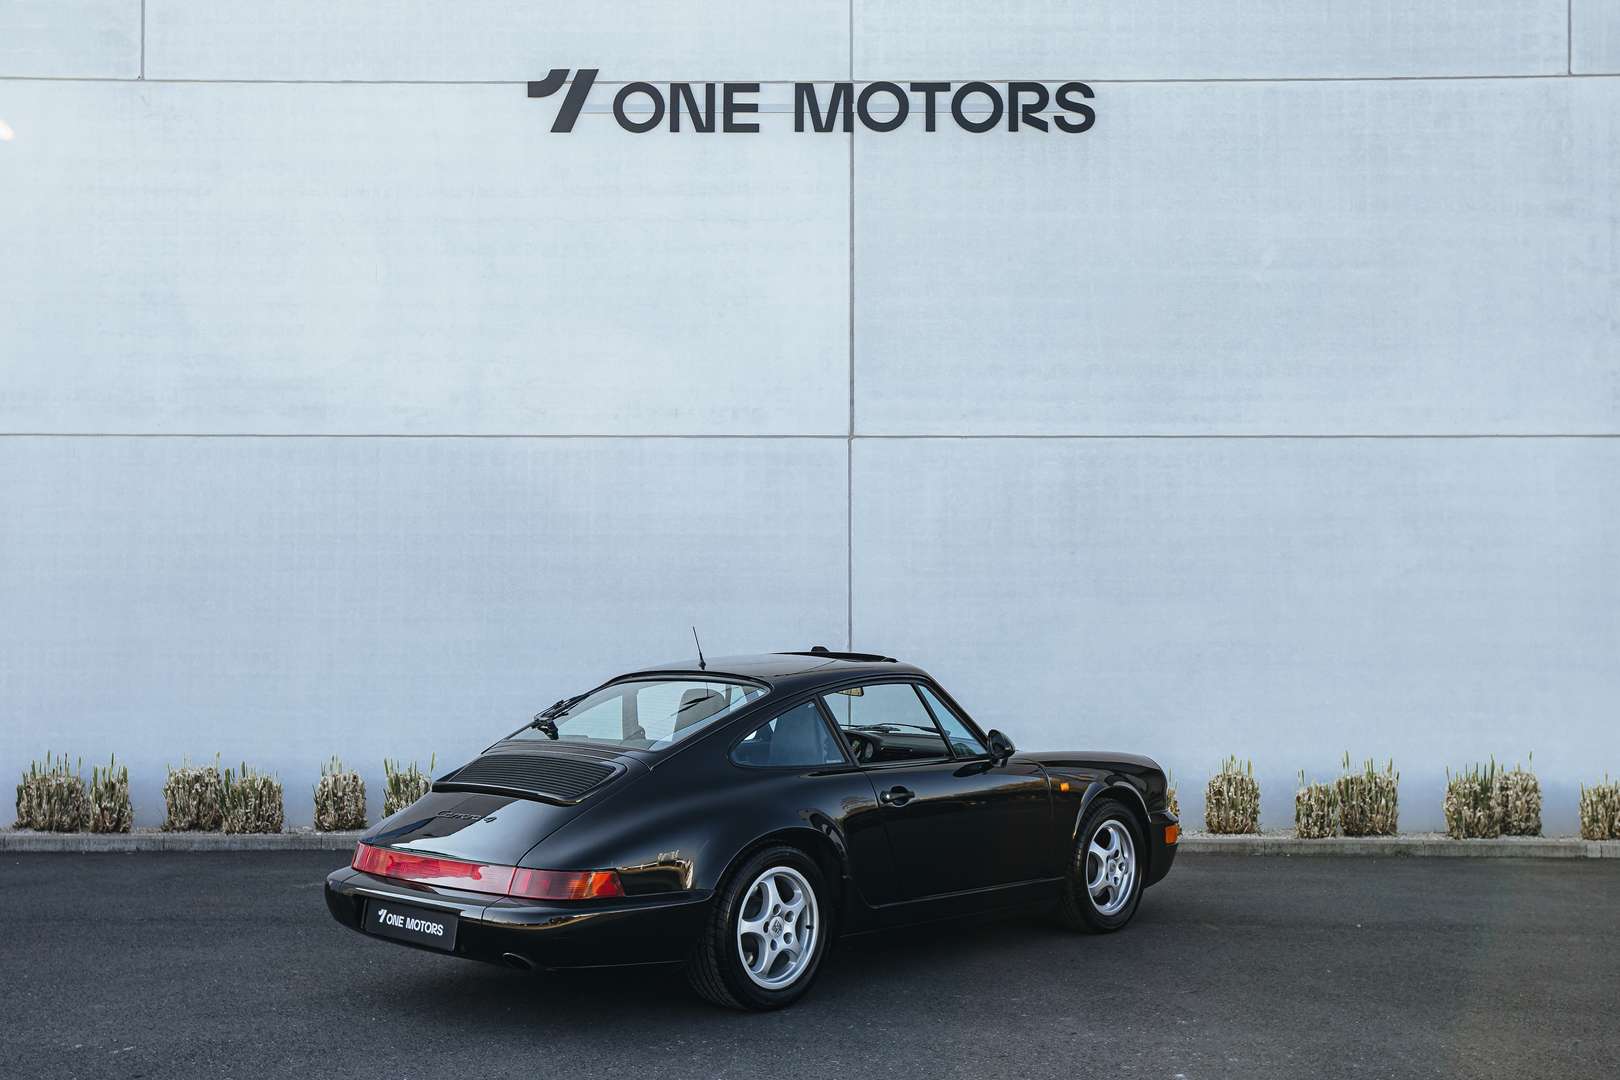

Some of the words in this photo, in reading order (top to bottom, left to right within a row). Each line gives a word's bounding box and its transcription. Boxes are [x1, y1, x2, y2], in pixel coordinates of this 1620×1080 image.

[613, 82, 759, 133] ONE
[795, 82, 1096, 133] MOTORS
[386, 914, 404, 927] ONE
[406, 918, 444, 936] MOTORS
